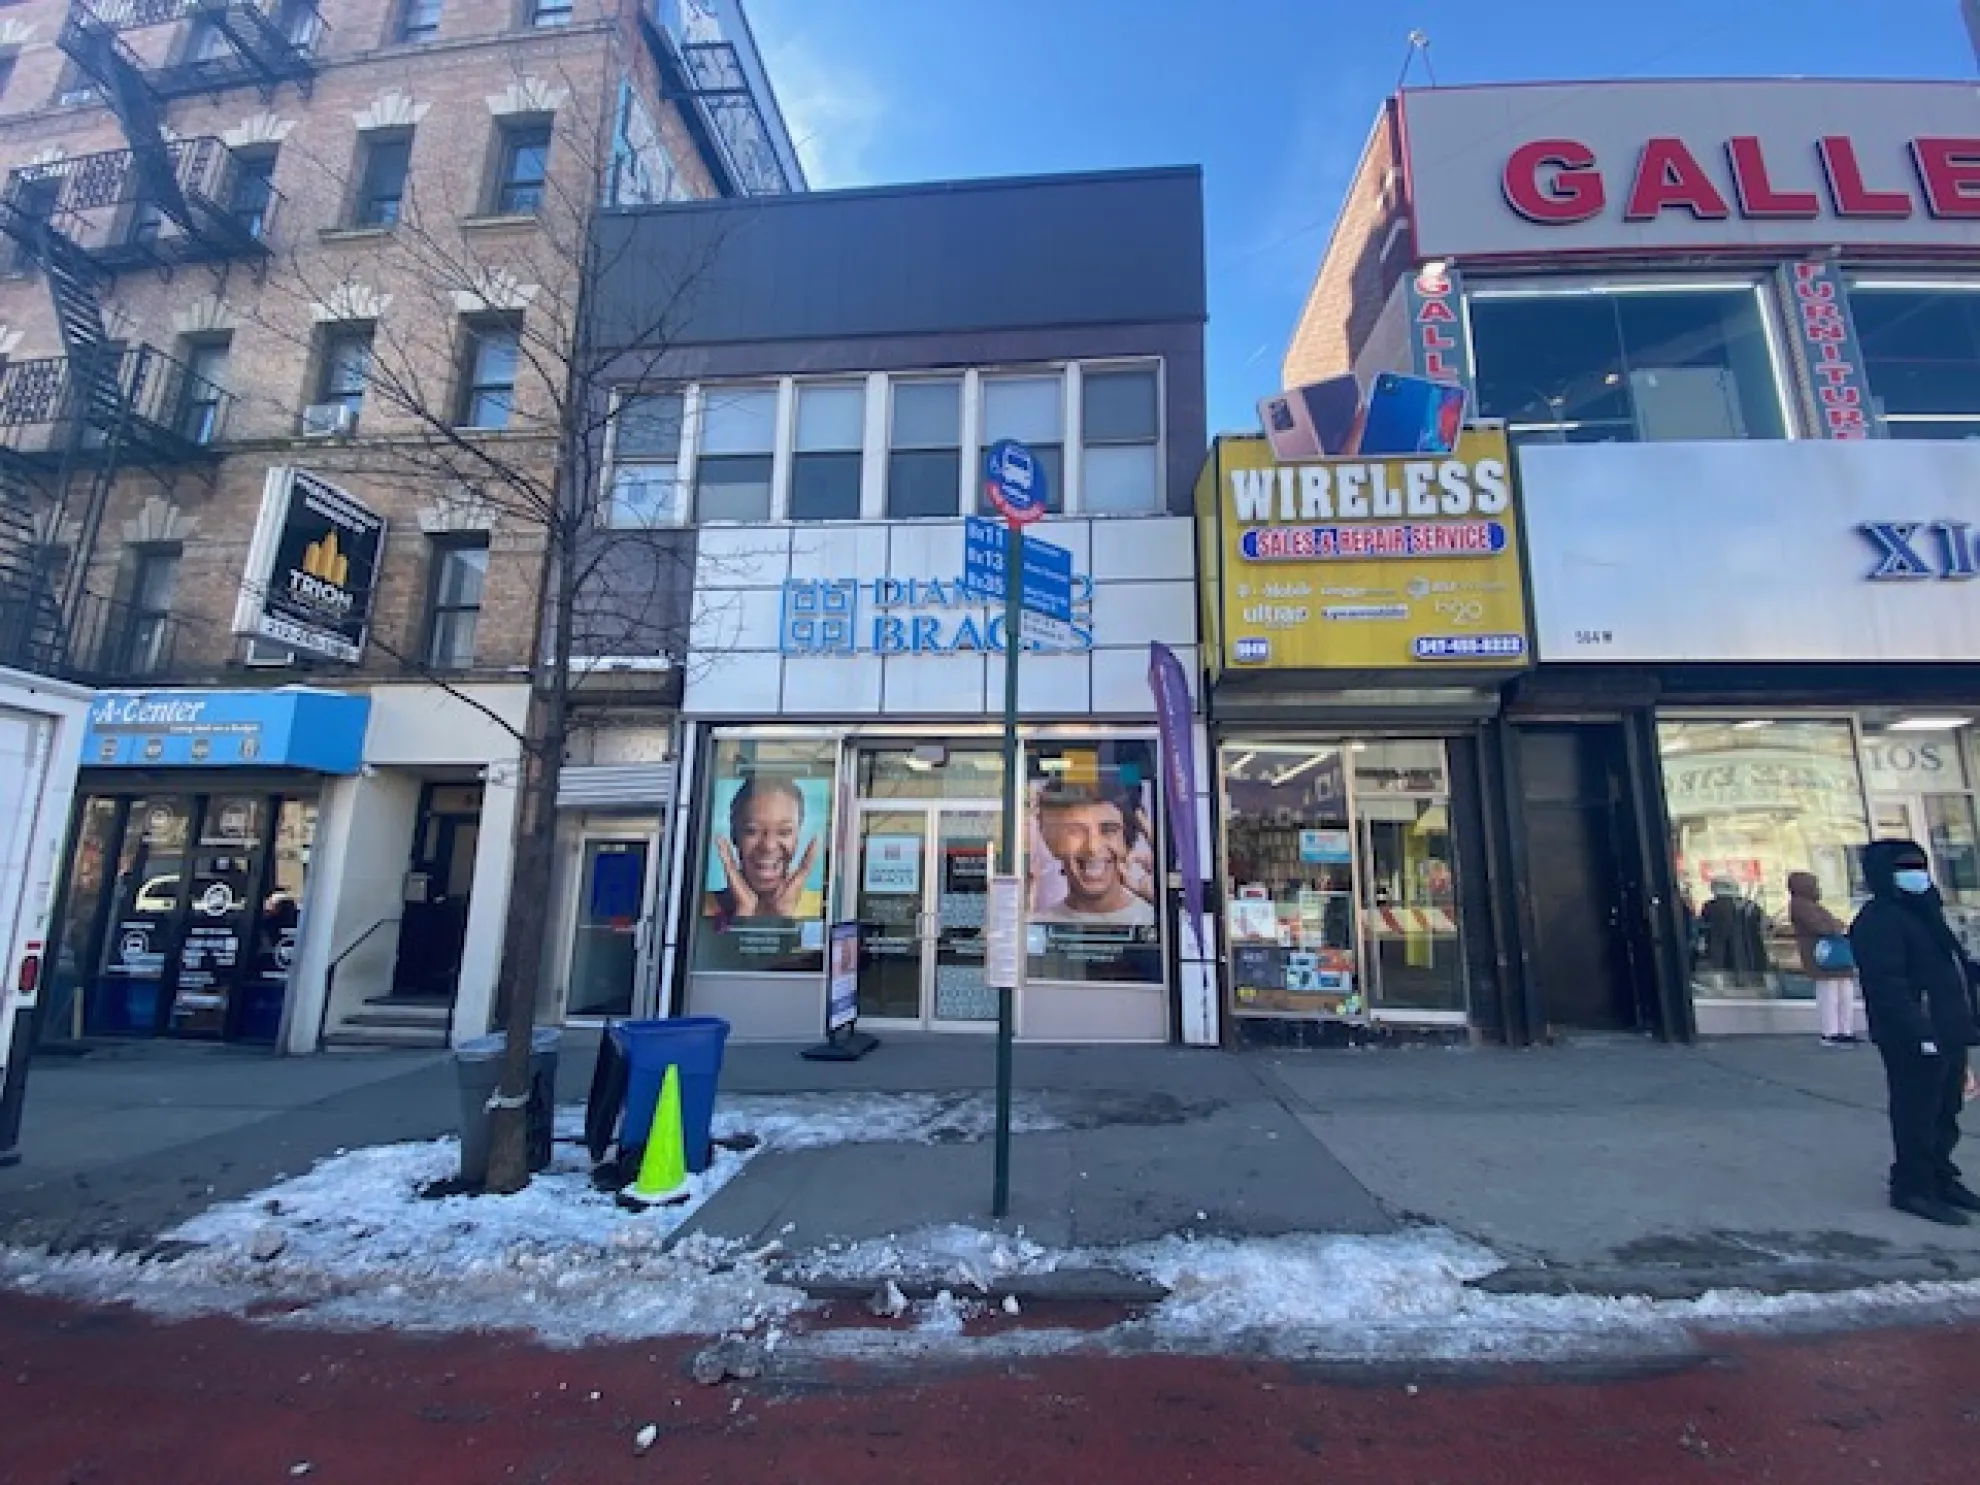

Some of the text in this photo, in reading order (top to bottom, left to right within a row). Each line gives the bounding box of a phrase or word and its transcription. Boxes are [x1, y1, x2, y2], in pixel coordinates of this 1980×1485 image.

[1503, 137, 1980, 222] GALLE
[1230, 459, 1508, 522] WIRELESS
[1258, 530, 1315, 556] SALES
[1340, 528, 1406, 553] REPAIR
[1410, 525, 1489, 550] SERVICE
